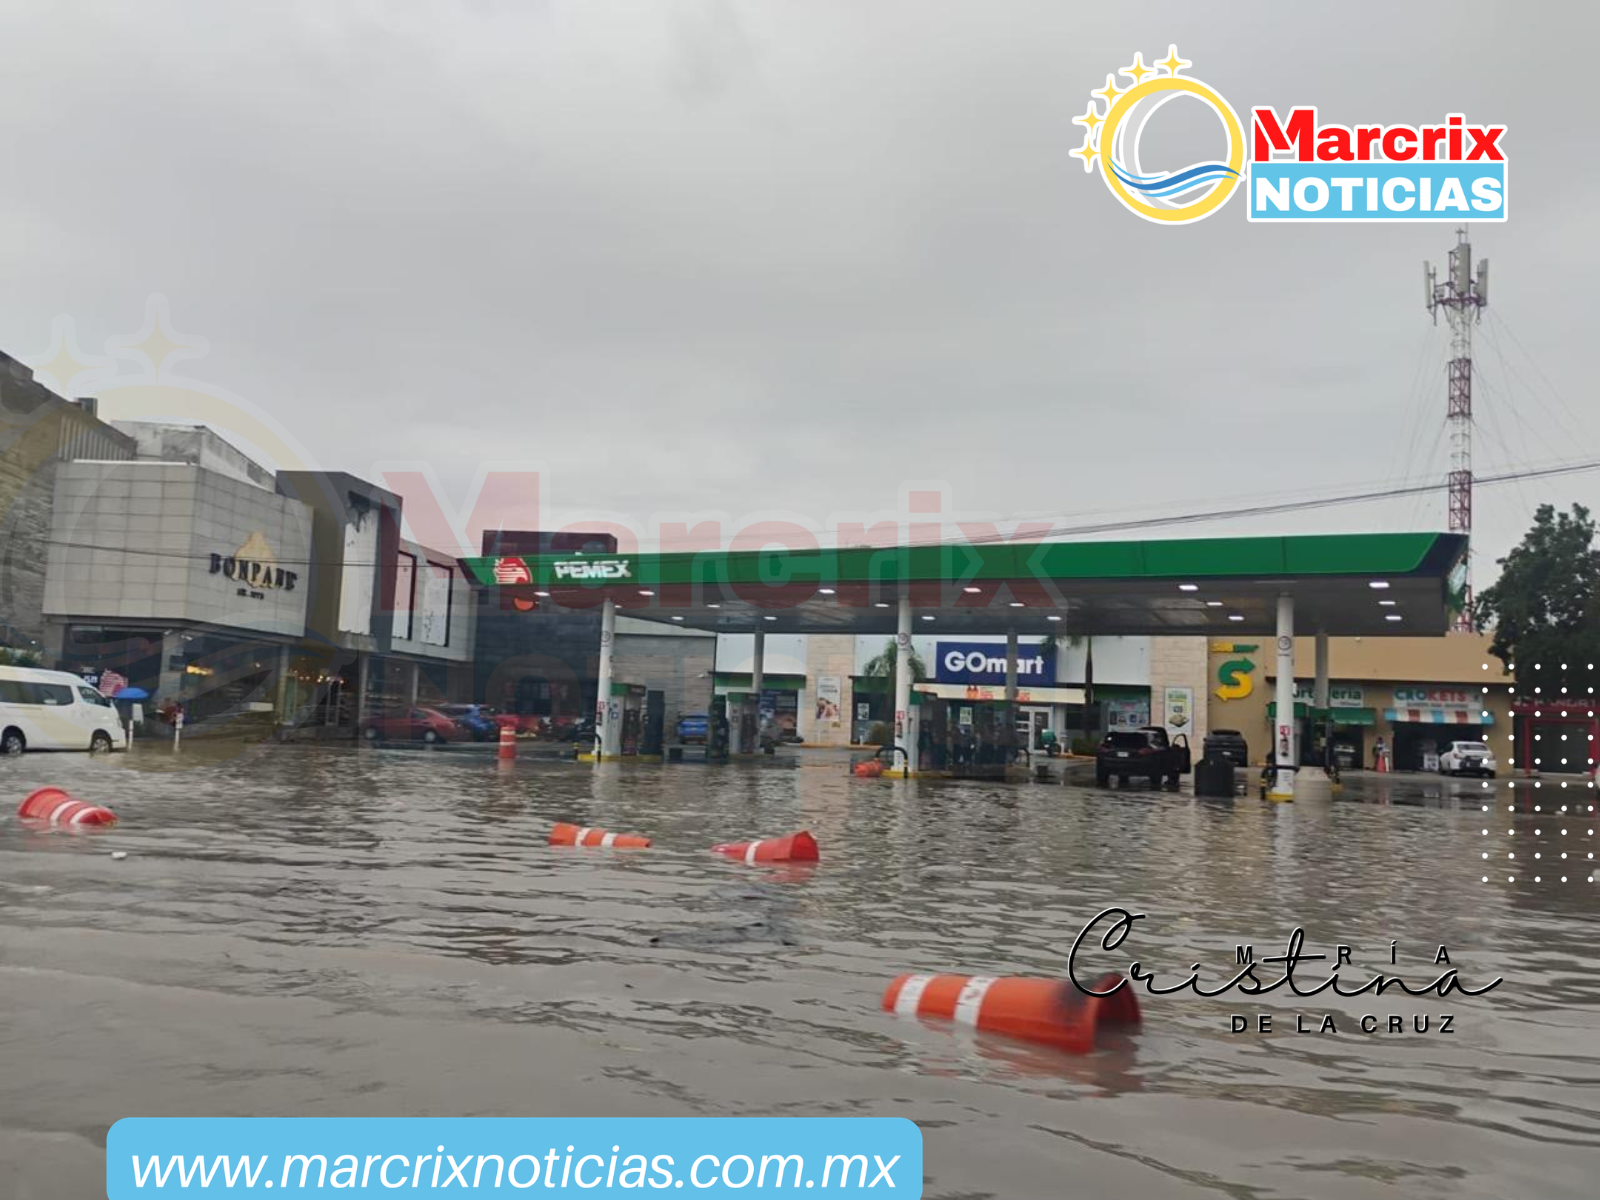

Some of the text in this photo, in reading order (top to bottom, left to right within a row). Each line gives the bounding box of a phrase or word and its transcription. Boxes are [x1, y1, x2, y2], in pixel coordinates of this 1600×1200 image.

[209, 552, 298, 591] BONPANE
[553, 560, 632, 579] PEMEX
[1394, 688, 1467, 702] CROKETS
